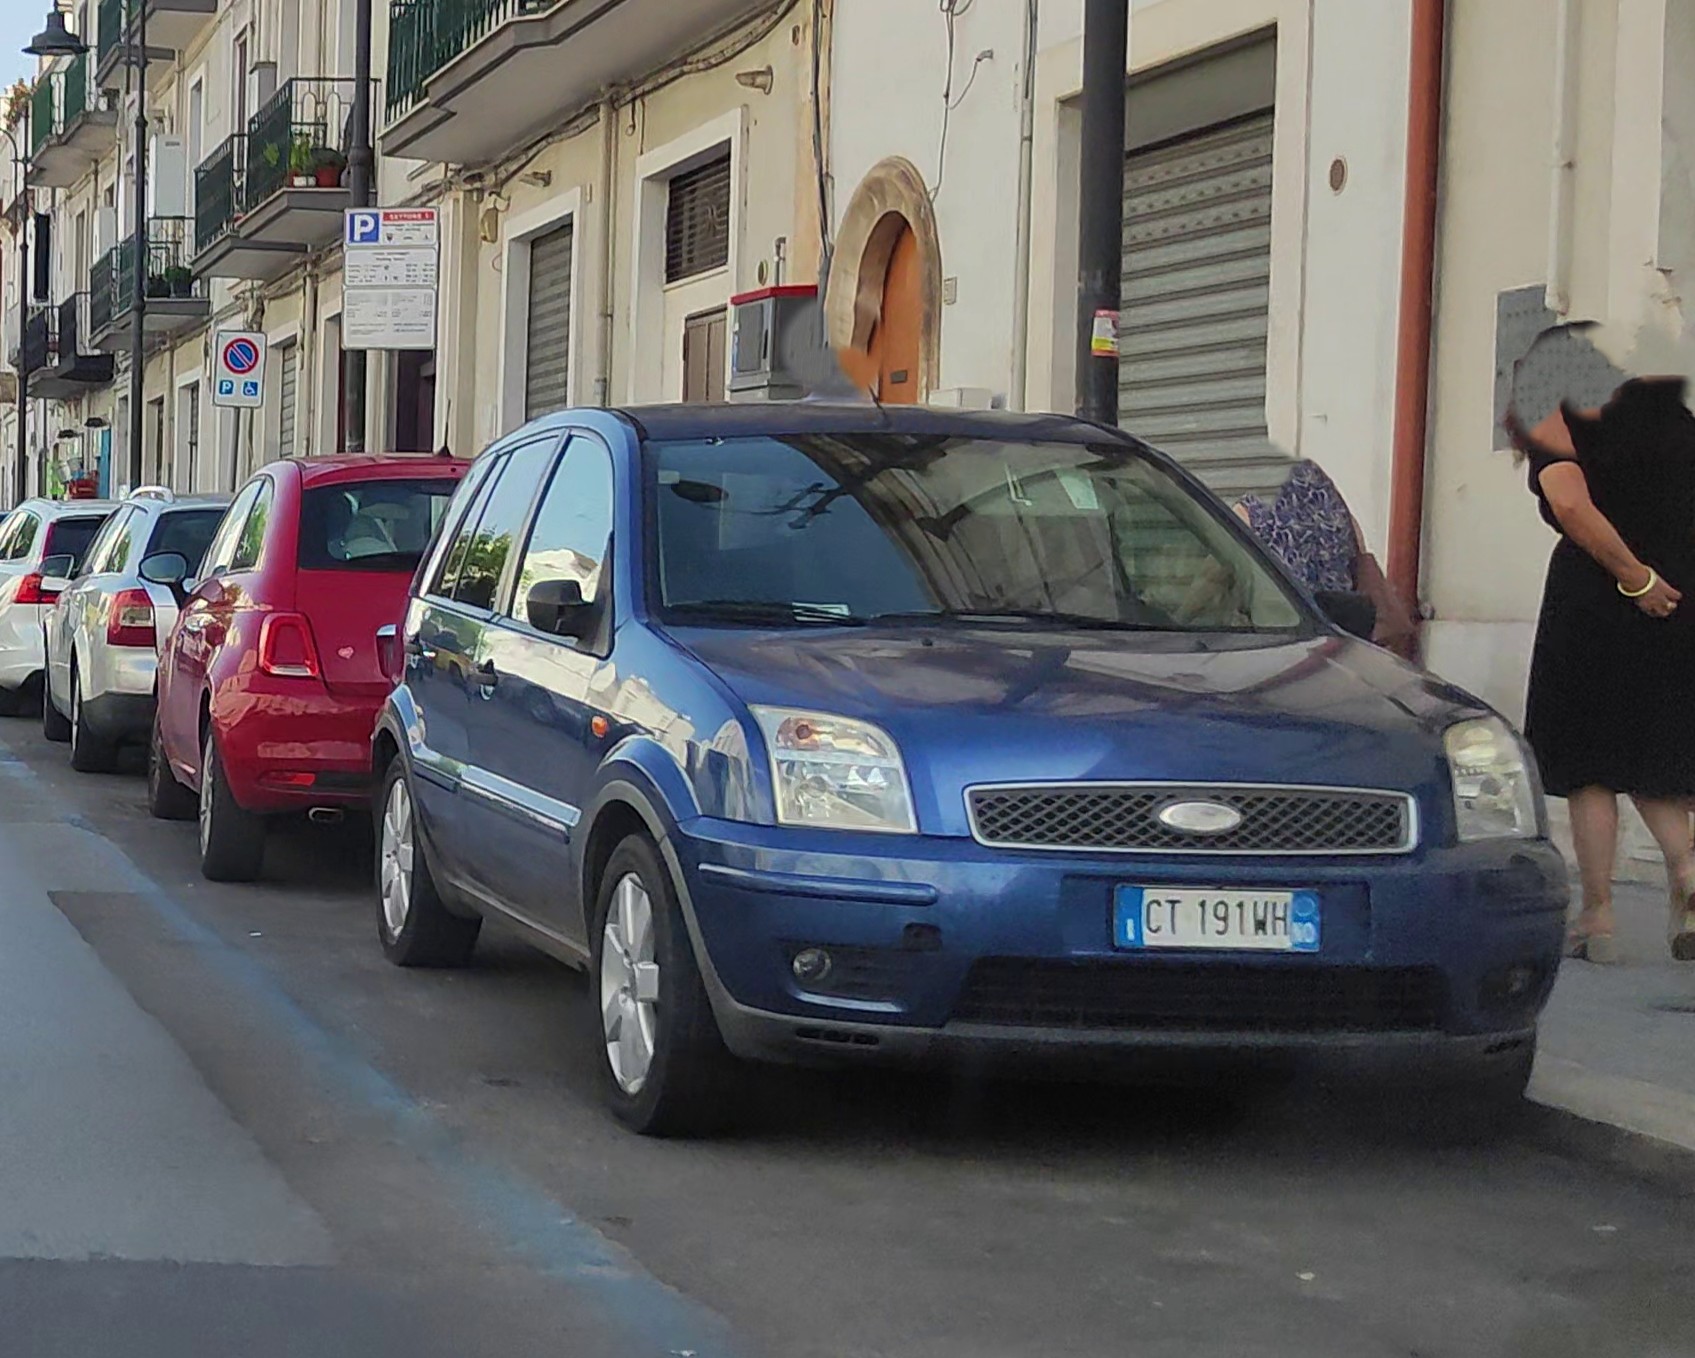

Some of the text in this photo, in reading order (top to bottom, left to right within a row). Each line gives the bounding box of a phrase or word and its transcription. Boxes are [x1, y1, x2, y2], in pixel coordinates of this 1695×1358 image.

[353, 214, 375, 241] P
[221, 381, 232, 394] P
[1145, 898, 1183, 935] CT
[1198, 899, 1289, 937] 191WH
